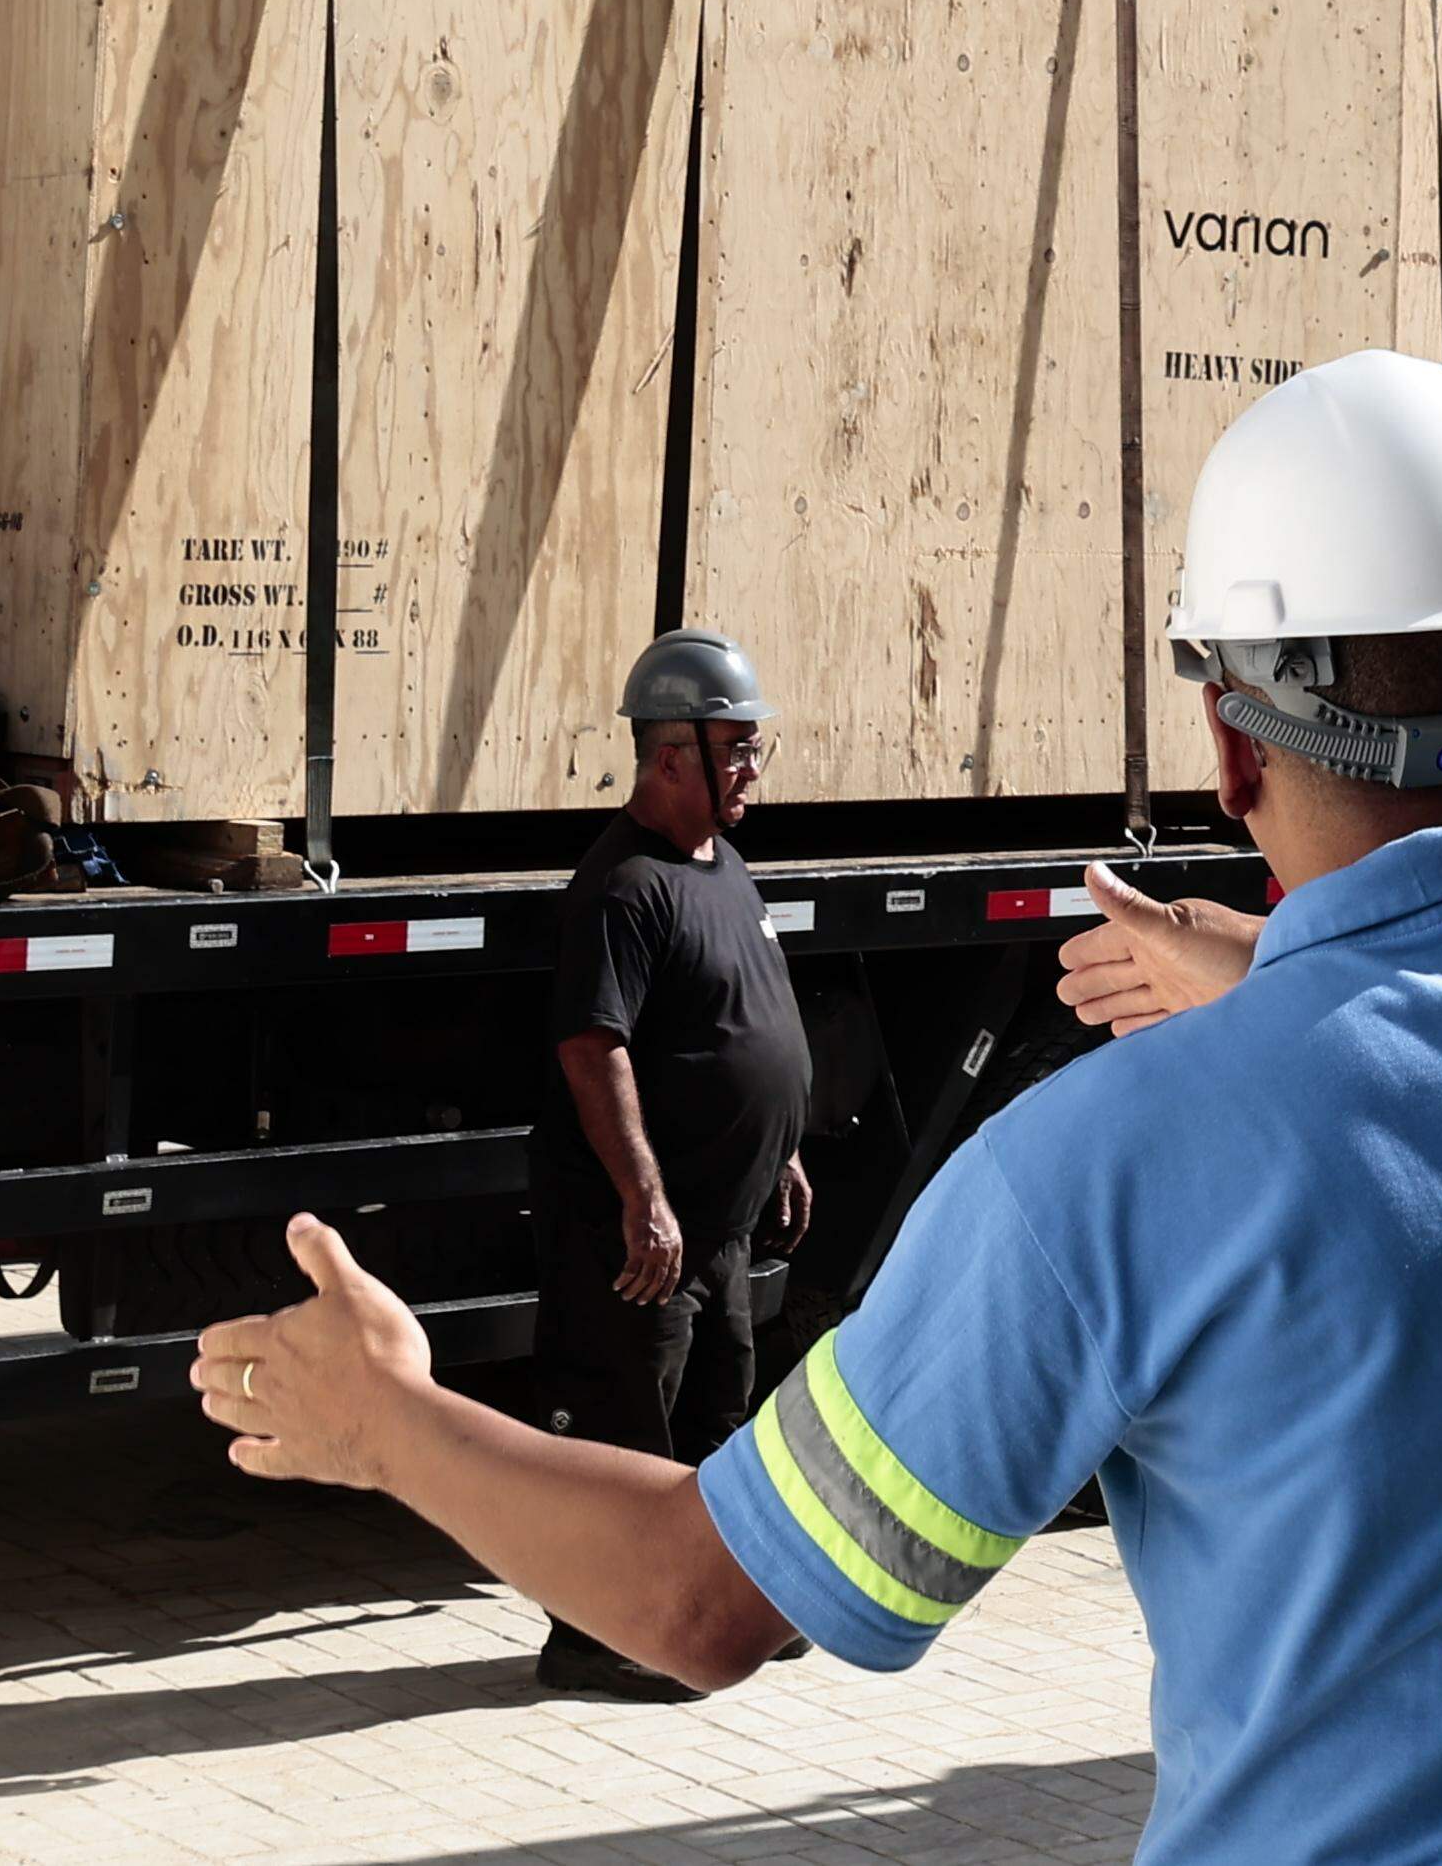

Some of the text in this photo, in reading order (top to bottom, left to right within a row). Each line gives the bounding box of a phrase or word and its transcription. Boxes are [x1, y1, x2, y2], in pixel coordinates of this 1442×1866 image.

[1163, 209, 1330, 259] varian
[1164, 350, 1244, 383] HEAVY
[180, 537, 244, 562] TARE
[250, 538, 292, 562] WT.
[374, 537, 390, 560] #
[178, 583, 388, 607] GROSS WT. #
[176, 623, 224, 648] O.D.
[231, 629, 271, 649] 116
[276, 629, 292, 649] X
[352, 628, 379, 649] 88
